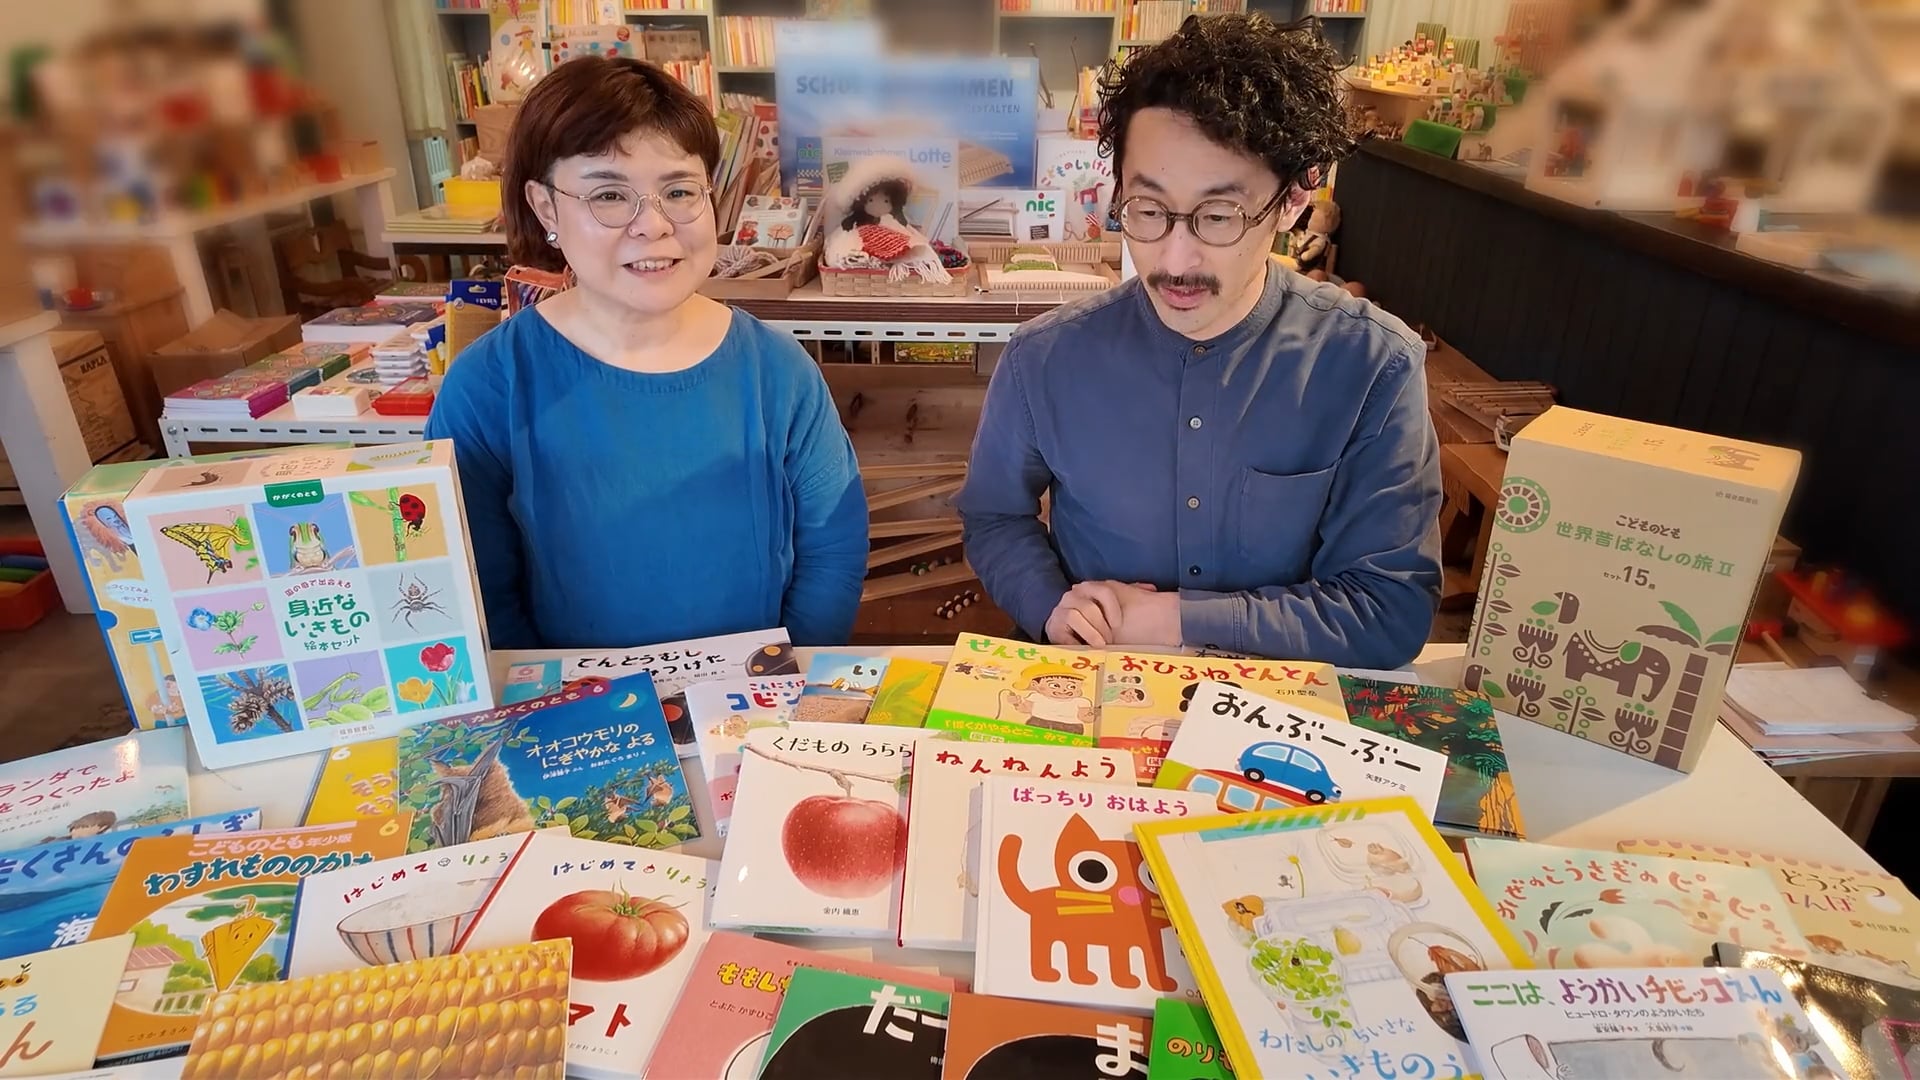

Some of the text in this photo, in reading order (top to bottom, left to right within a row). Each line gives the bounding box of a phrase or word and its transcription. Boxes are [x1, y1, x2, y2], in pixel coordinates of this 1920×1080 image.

[909, 148, 952, 165] Lotte
[1026, 192, 1056, 212] nic
[79, 355, 108, 375] KAPLA
[272, 490, 318, 501] かがくのとも
[1615, 514, 1681, 539] こどものとも
[1555, 520, 1714, 573] 世界昔ばなしの旅
[287, 594, 356, 619] 身近な
[284, 611, 370, 638] いきもの
[304, 634, 361, 652] 絵本セット
[577, 649, 703, 668] てんとうむし
[471, 692, 581, 724] かがくのとも
[593, 685, 604, 694] 6
[525, 723, 640, 758] オオコウモリの
[1211, 691, 1422, 773] おんぶーぶー
[331, 746, 352, 761] 6
[541, 732, 656, 768] にぎやかな よる
[772, 737, 913, 758] くだもの ららら
[935, 750, 1117, 779] ねんねんよう
[1365, 773, 1408, 792] 矢野アケミ
[1013, 787, 1189, 817] ぱっちり おはよう
[379, 819, 400, 837] 6
[552, 859, 636, 876] はじめて
[342, 862, 430, 904] はじめて
[1781, 868, 1886, 898] どうぶつ
[708, 1000, 774, 1022] とよた かずひこ
[1259, 1018, 1417, 1054] わたしの ちいさな
